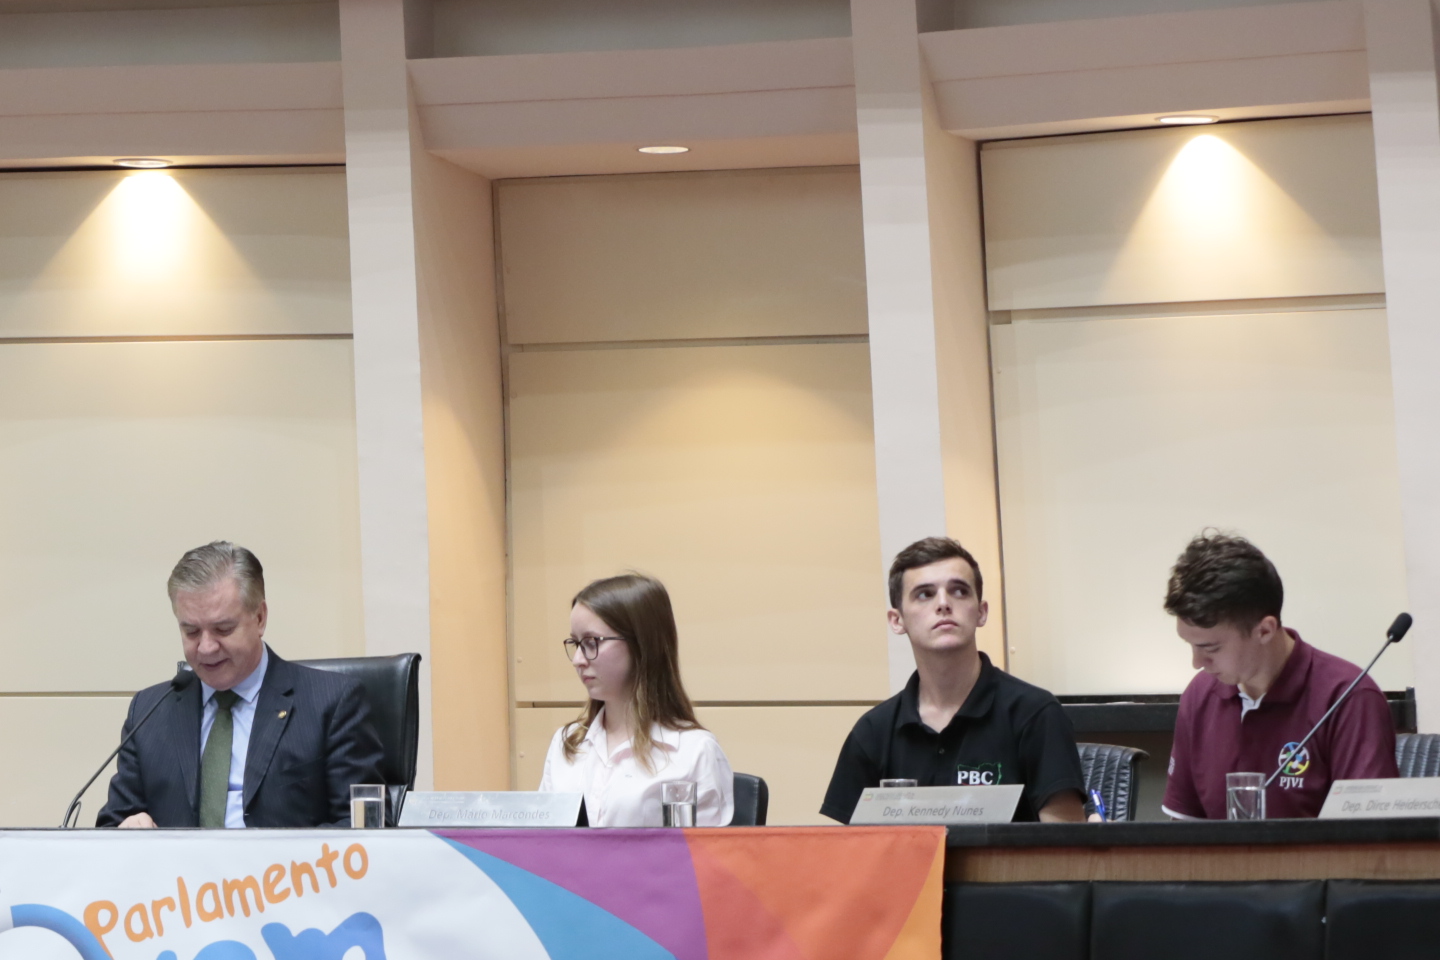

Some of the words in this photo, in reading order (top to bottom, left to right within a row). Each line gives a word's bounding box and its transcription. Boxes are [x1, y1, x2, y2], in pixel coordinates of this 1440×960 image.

[957, 770, 994, 785] PBC
[1279, 776, 1304, 790] PJVI
[882, 806, 904, 818] Dep.
[907, 805, 951, 819] Kennedy
[952, 806, 985, 816] Nunes
[1341, 800, 1362, 814] Dep.
[1365, 799, 1391, 811] Dirce
[428, 809, 452, 822] Dep.
[490, 809, 550, 820] Marcondes
